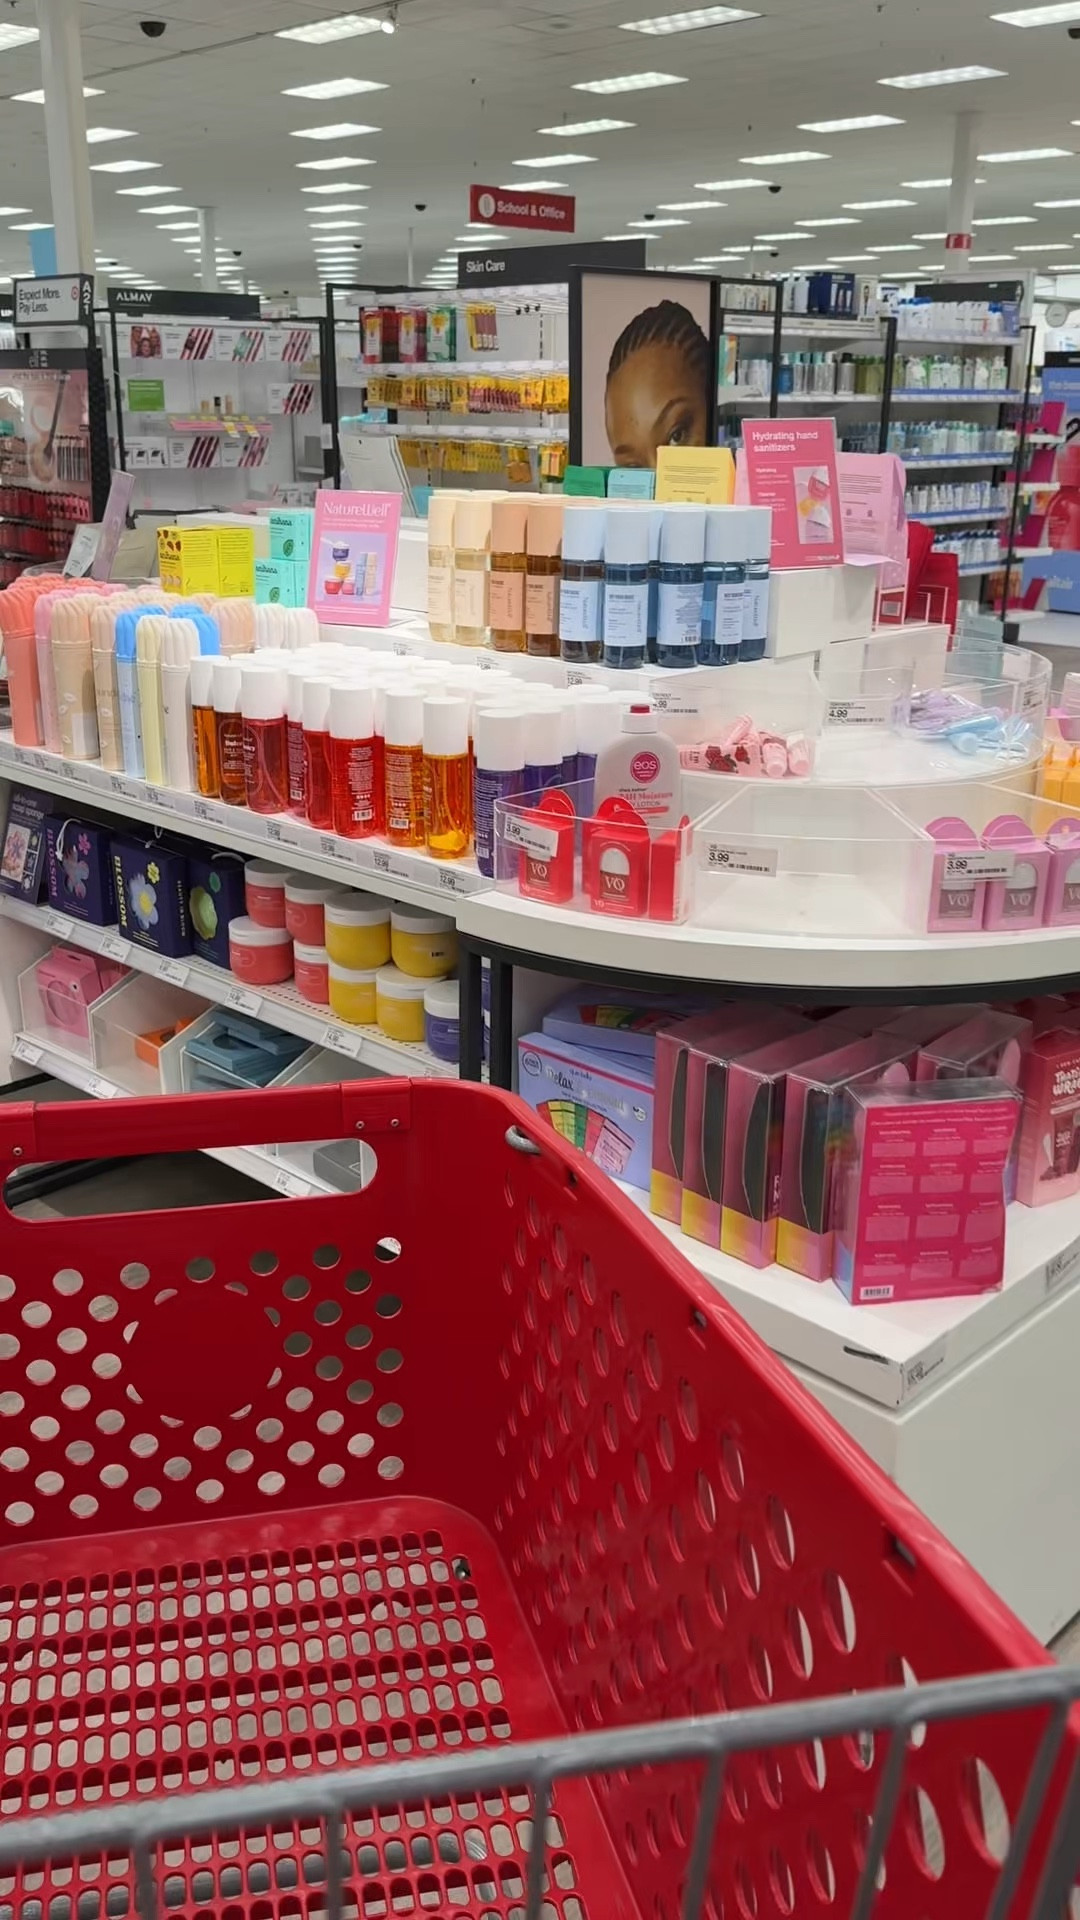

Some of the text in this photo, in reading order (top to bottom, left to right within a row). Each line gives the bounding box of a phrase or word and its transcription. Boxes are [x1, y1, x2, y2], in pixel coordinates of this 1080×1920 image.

[497, 200, 566, 220] School & Office
[466, 260, 506, 273] Skin Care
[18, 287, 61, 302] Expect More.
[116, 291, 153, 303] ALMAY
[19, 301, 49, 315] Pay Less.
[752, 431, 819, 443] Hydrating hand
[753, 443, 796, 453] sanitizers
[828, 709, 848, 719] 4.99
[633, 760, 657, 770] eos
[505, 823, 521, 836] 3.99
[708, 851, 730, 863] 3.99
[946, 859, 968, 870] 3.99
[440, 874, 456, 887] 12.99
[113, 855, 128, 929] BLOSSOM
